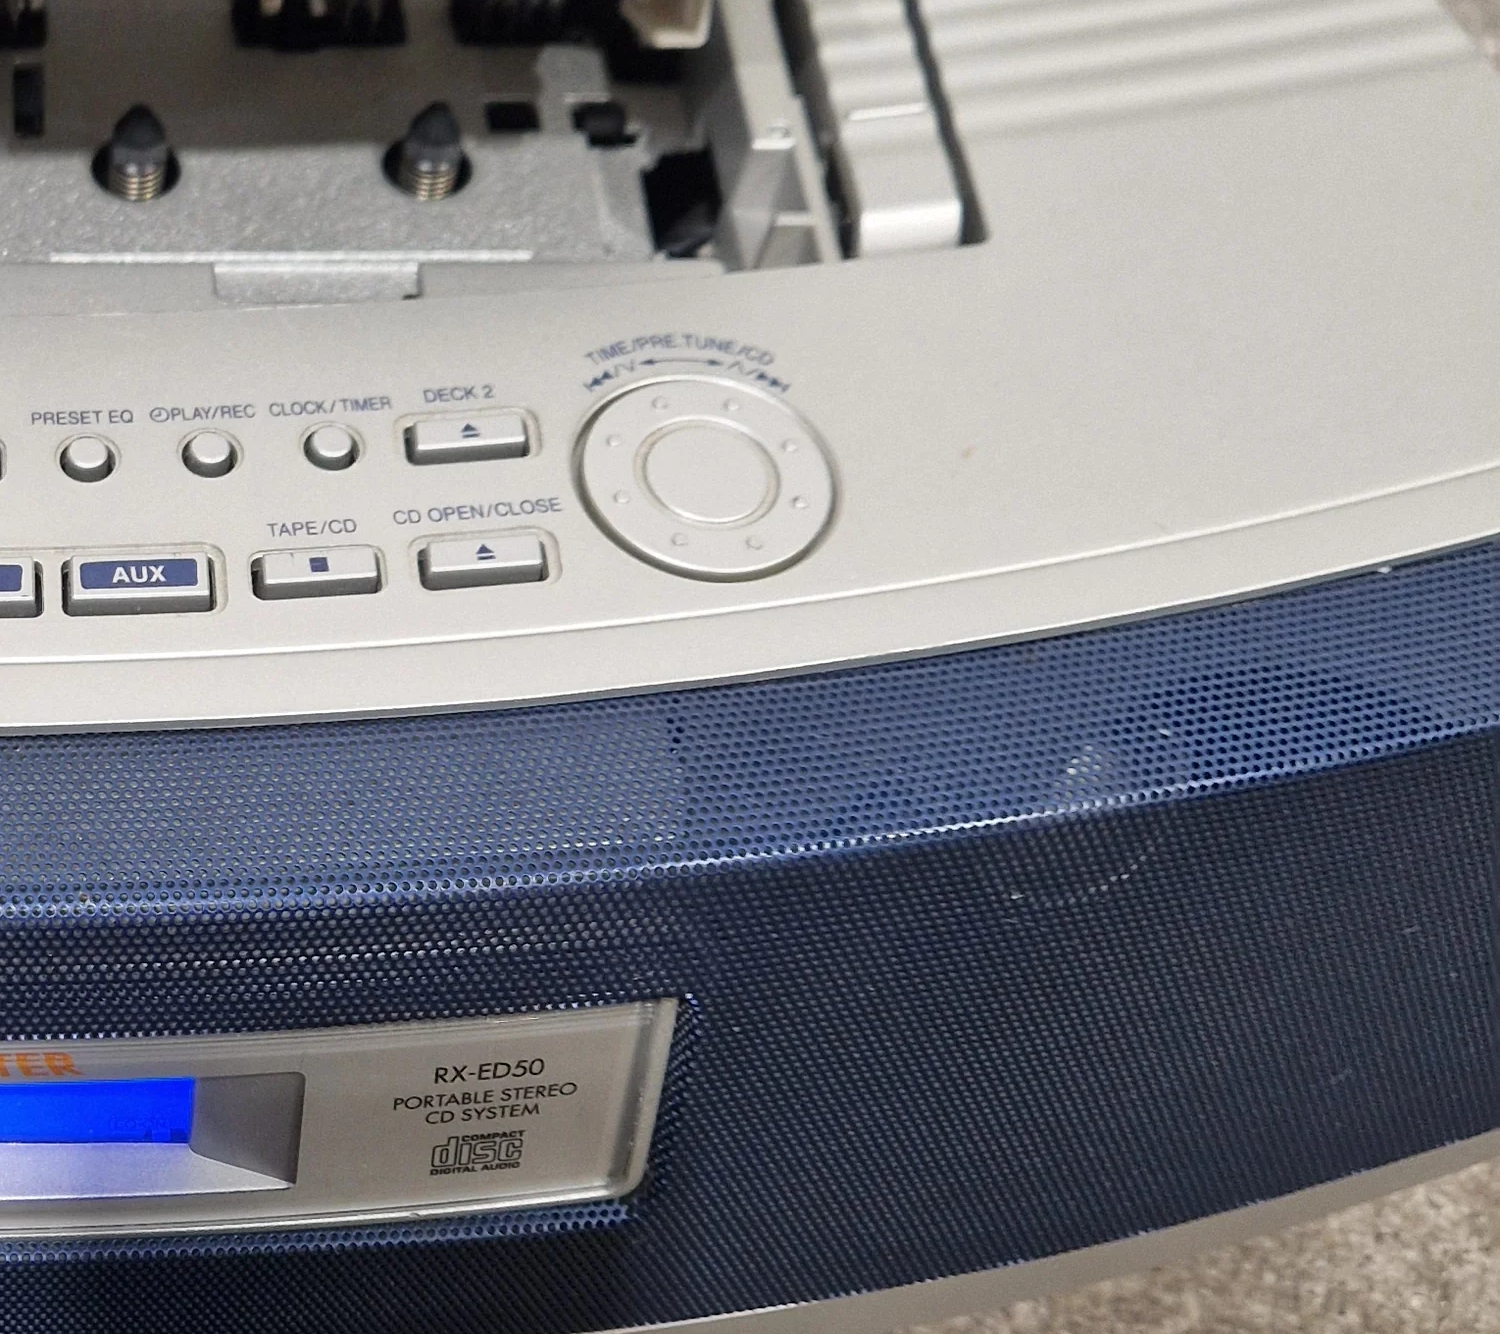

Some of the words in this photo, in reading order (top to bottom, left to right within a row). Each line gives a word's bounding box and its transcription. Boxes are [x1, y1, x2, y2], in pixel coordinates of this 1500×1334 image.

[422, 385, 477, 404] DECK
[481, 384, 495, 399] 2
[30, 410, 103, 426] PRESET
[108, 409, 134, 424] EQ
[392, 509, 422, 525] CD
[428, 497, 563, 523] OPEN/CLOSE
[266, 518, 357, 537] TAPE/CD
[112, 565, 167, 584] AUX
[434, 1058, 545, 1085] RX-ED50
[393, 1089, 494, 1110] PORTABLE
[499, 1082, 578, 1102] STEREO
[424, 1110, 455, 1125] CD
[460, 1103, 540, 1122] SYSTEM
[430, 1166, 477, 1176] DIGITAL
[481, 1161, 520, 1172] AUDIO
